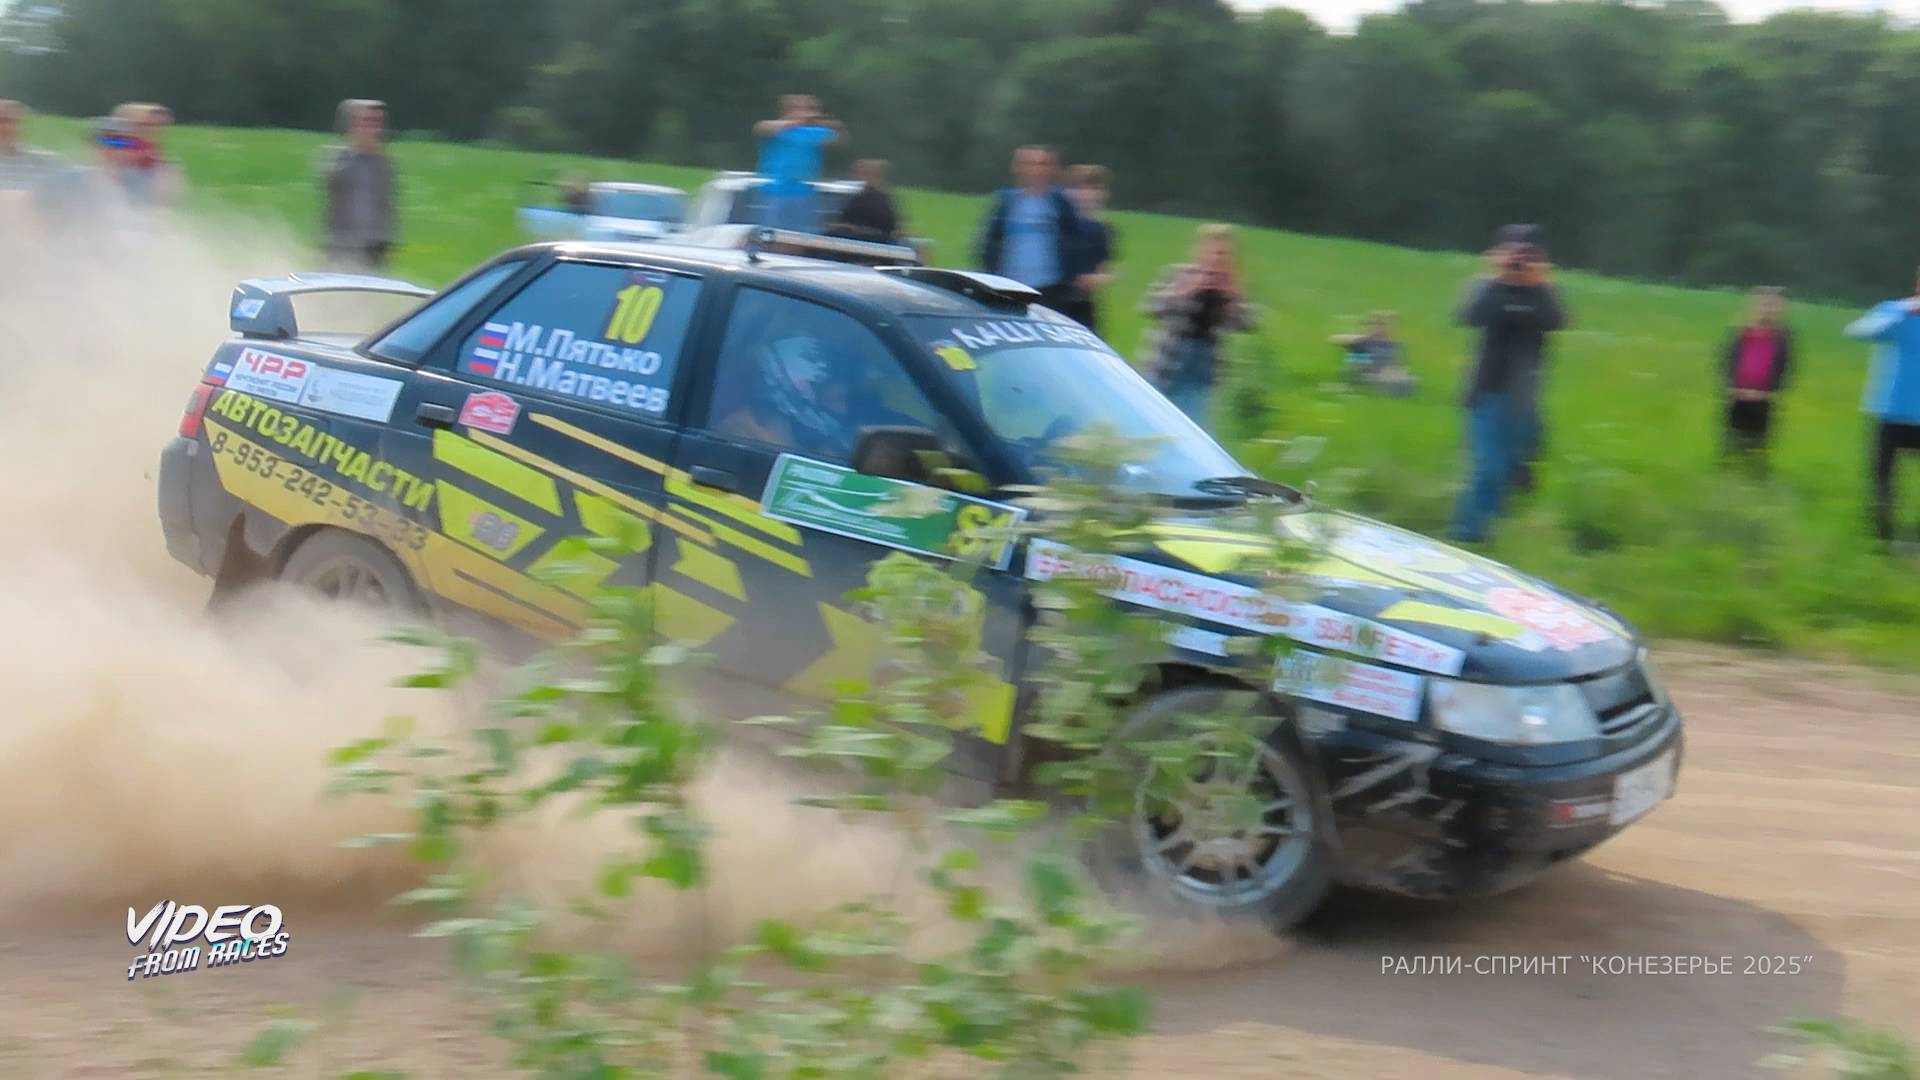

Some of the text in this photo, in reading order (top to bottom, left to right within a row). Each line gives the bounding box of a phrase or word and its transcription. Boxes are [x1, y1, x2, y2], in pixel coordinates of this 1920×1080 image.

[605, 284, 664, 345] 10
[503, 320, 662, 376] М.Пятько
[493, 350, 670, 413] Н.Матвеев
[210, 389, 436, 512] АВТОЗАПЧАСТИ
